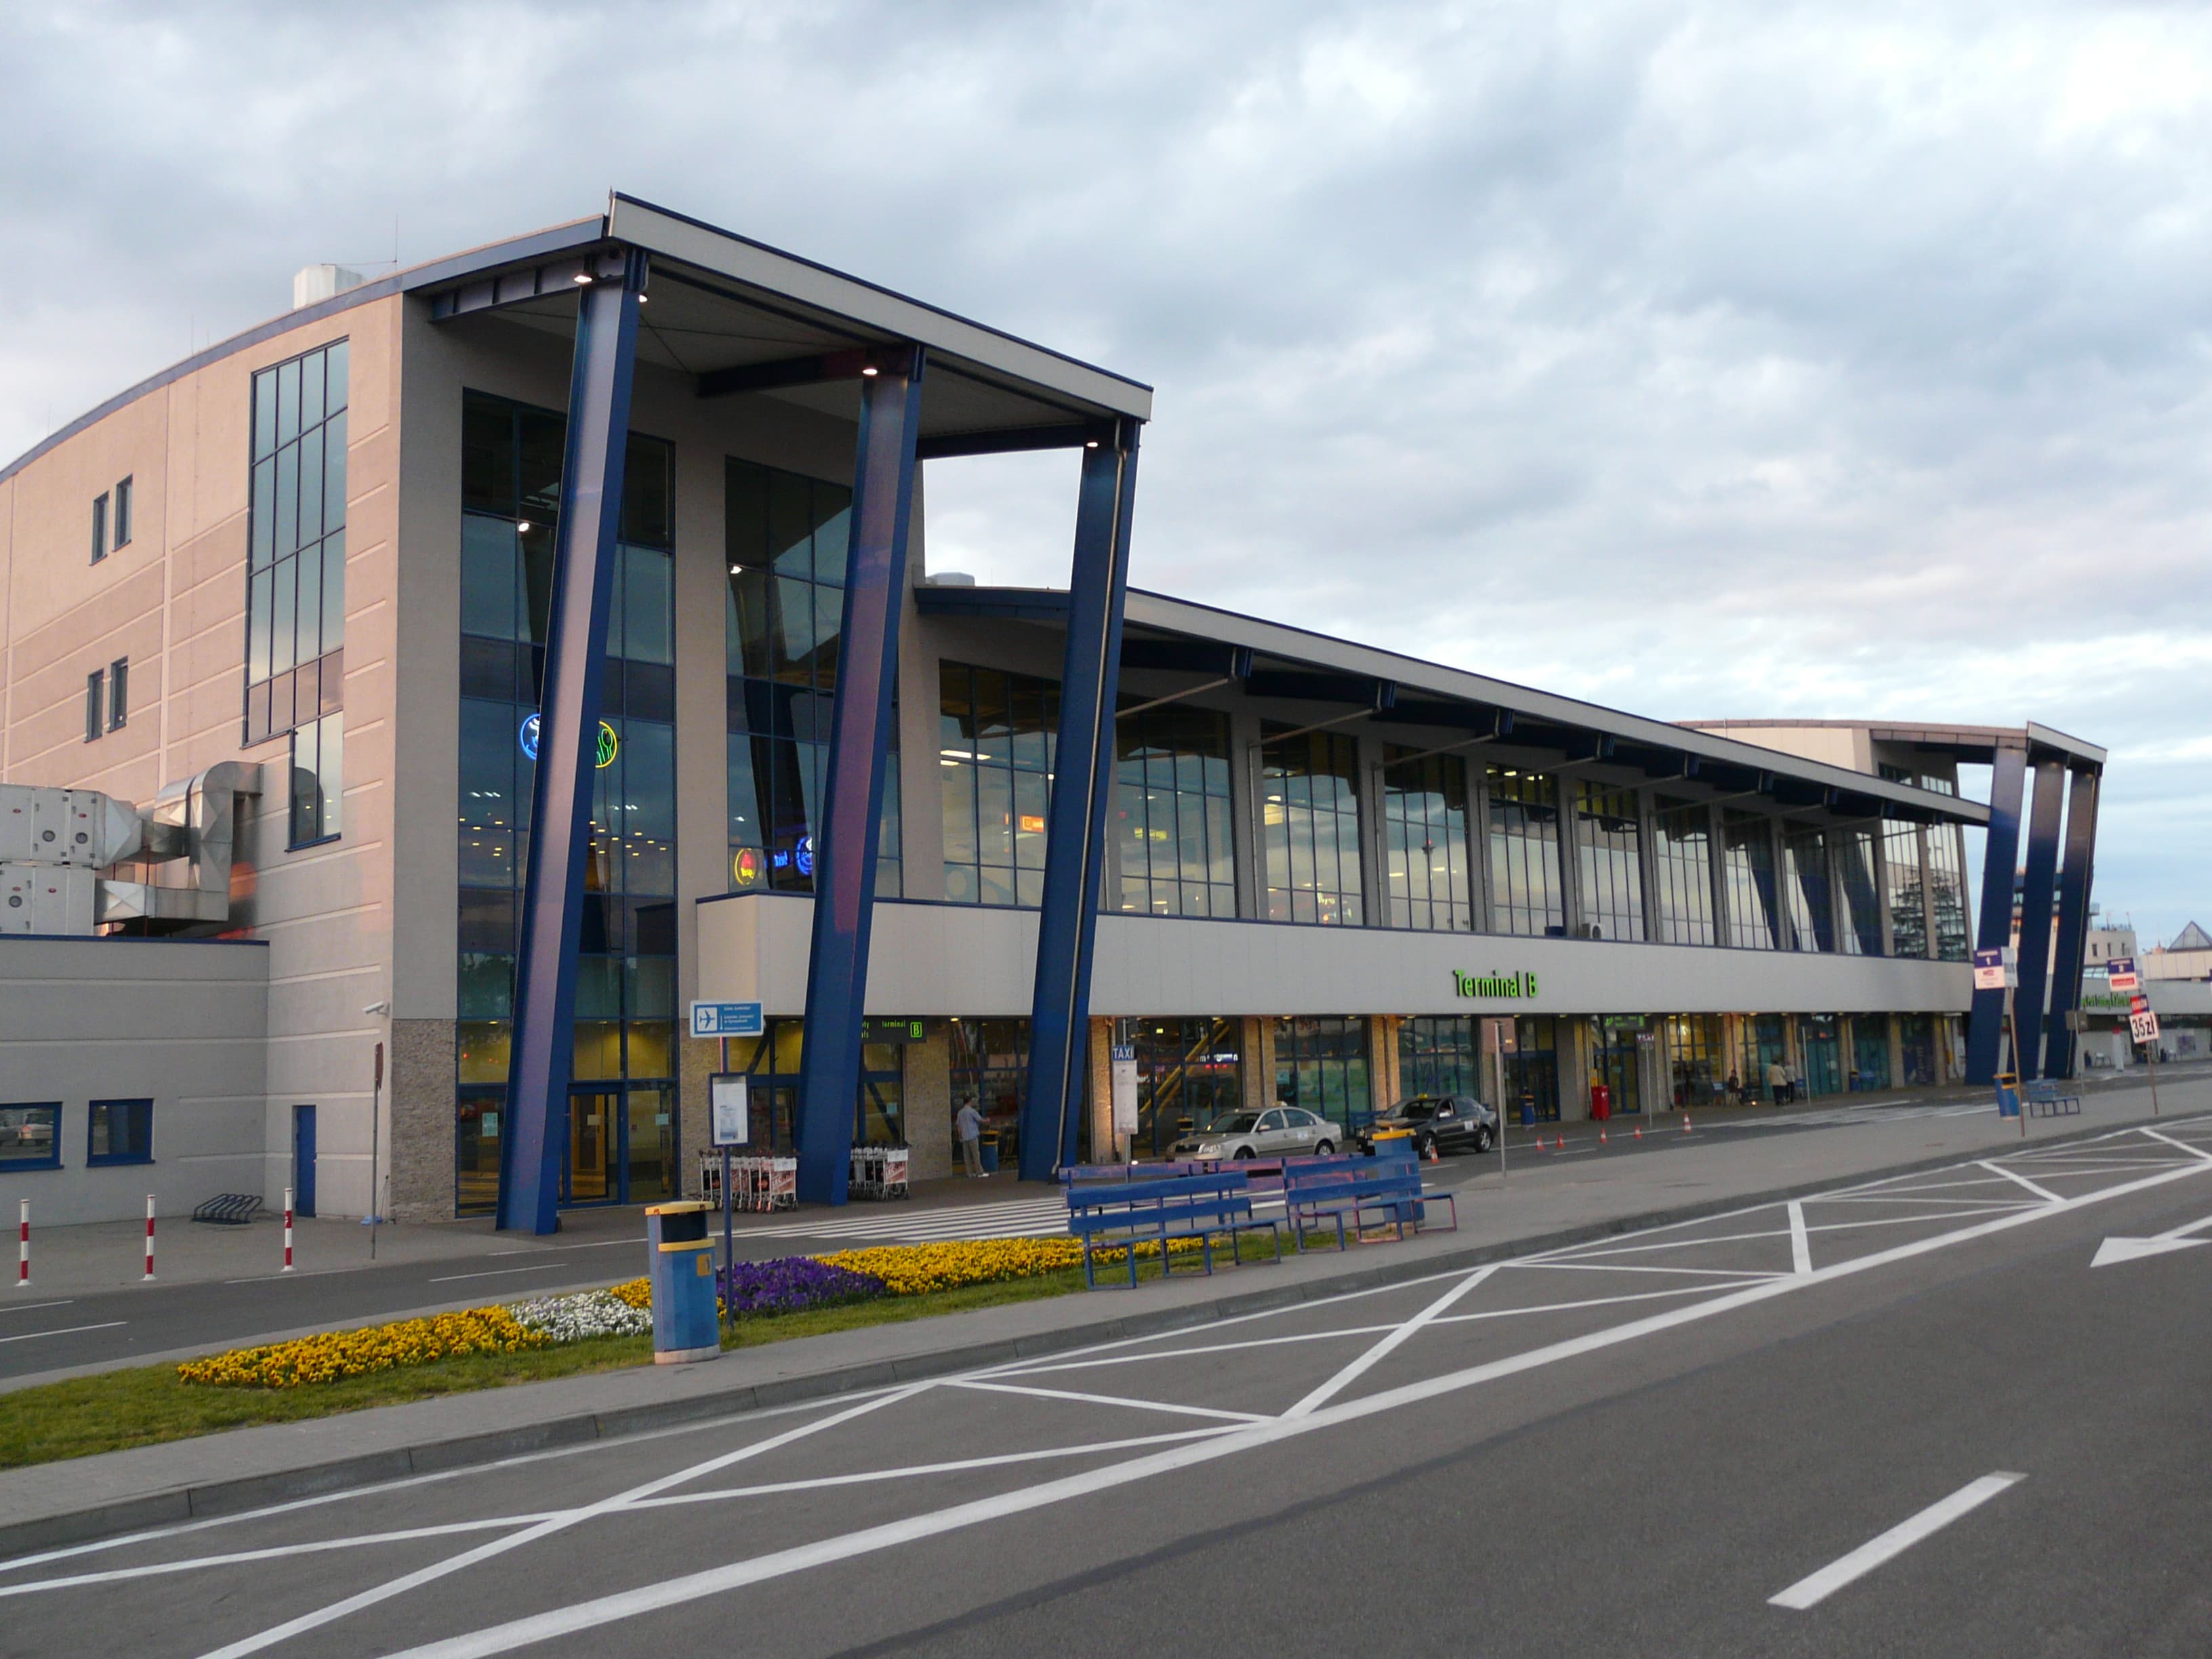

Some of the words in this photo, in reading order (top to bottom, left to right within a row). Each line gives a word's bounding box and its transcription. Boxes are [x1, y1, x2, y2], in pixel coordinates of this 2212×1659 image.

[1452, 969, 1524, 998] Terminal
[1525, 970, 1539, 998] B
[912, 1023, 920, 1036] B
[1637, 1033, 1655, 1042] TAXI
[1112, 1047, 1134, 1059] TAXI
